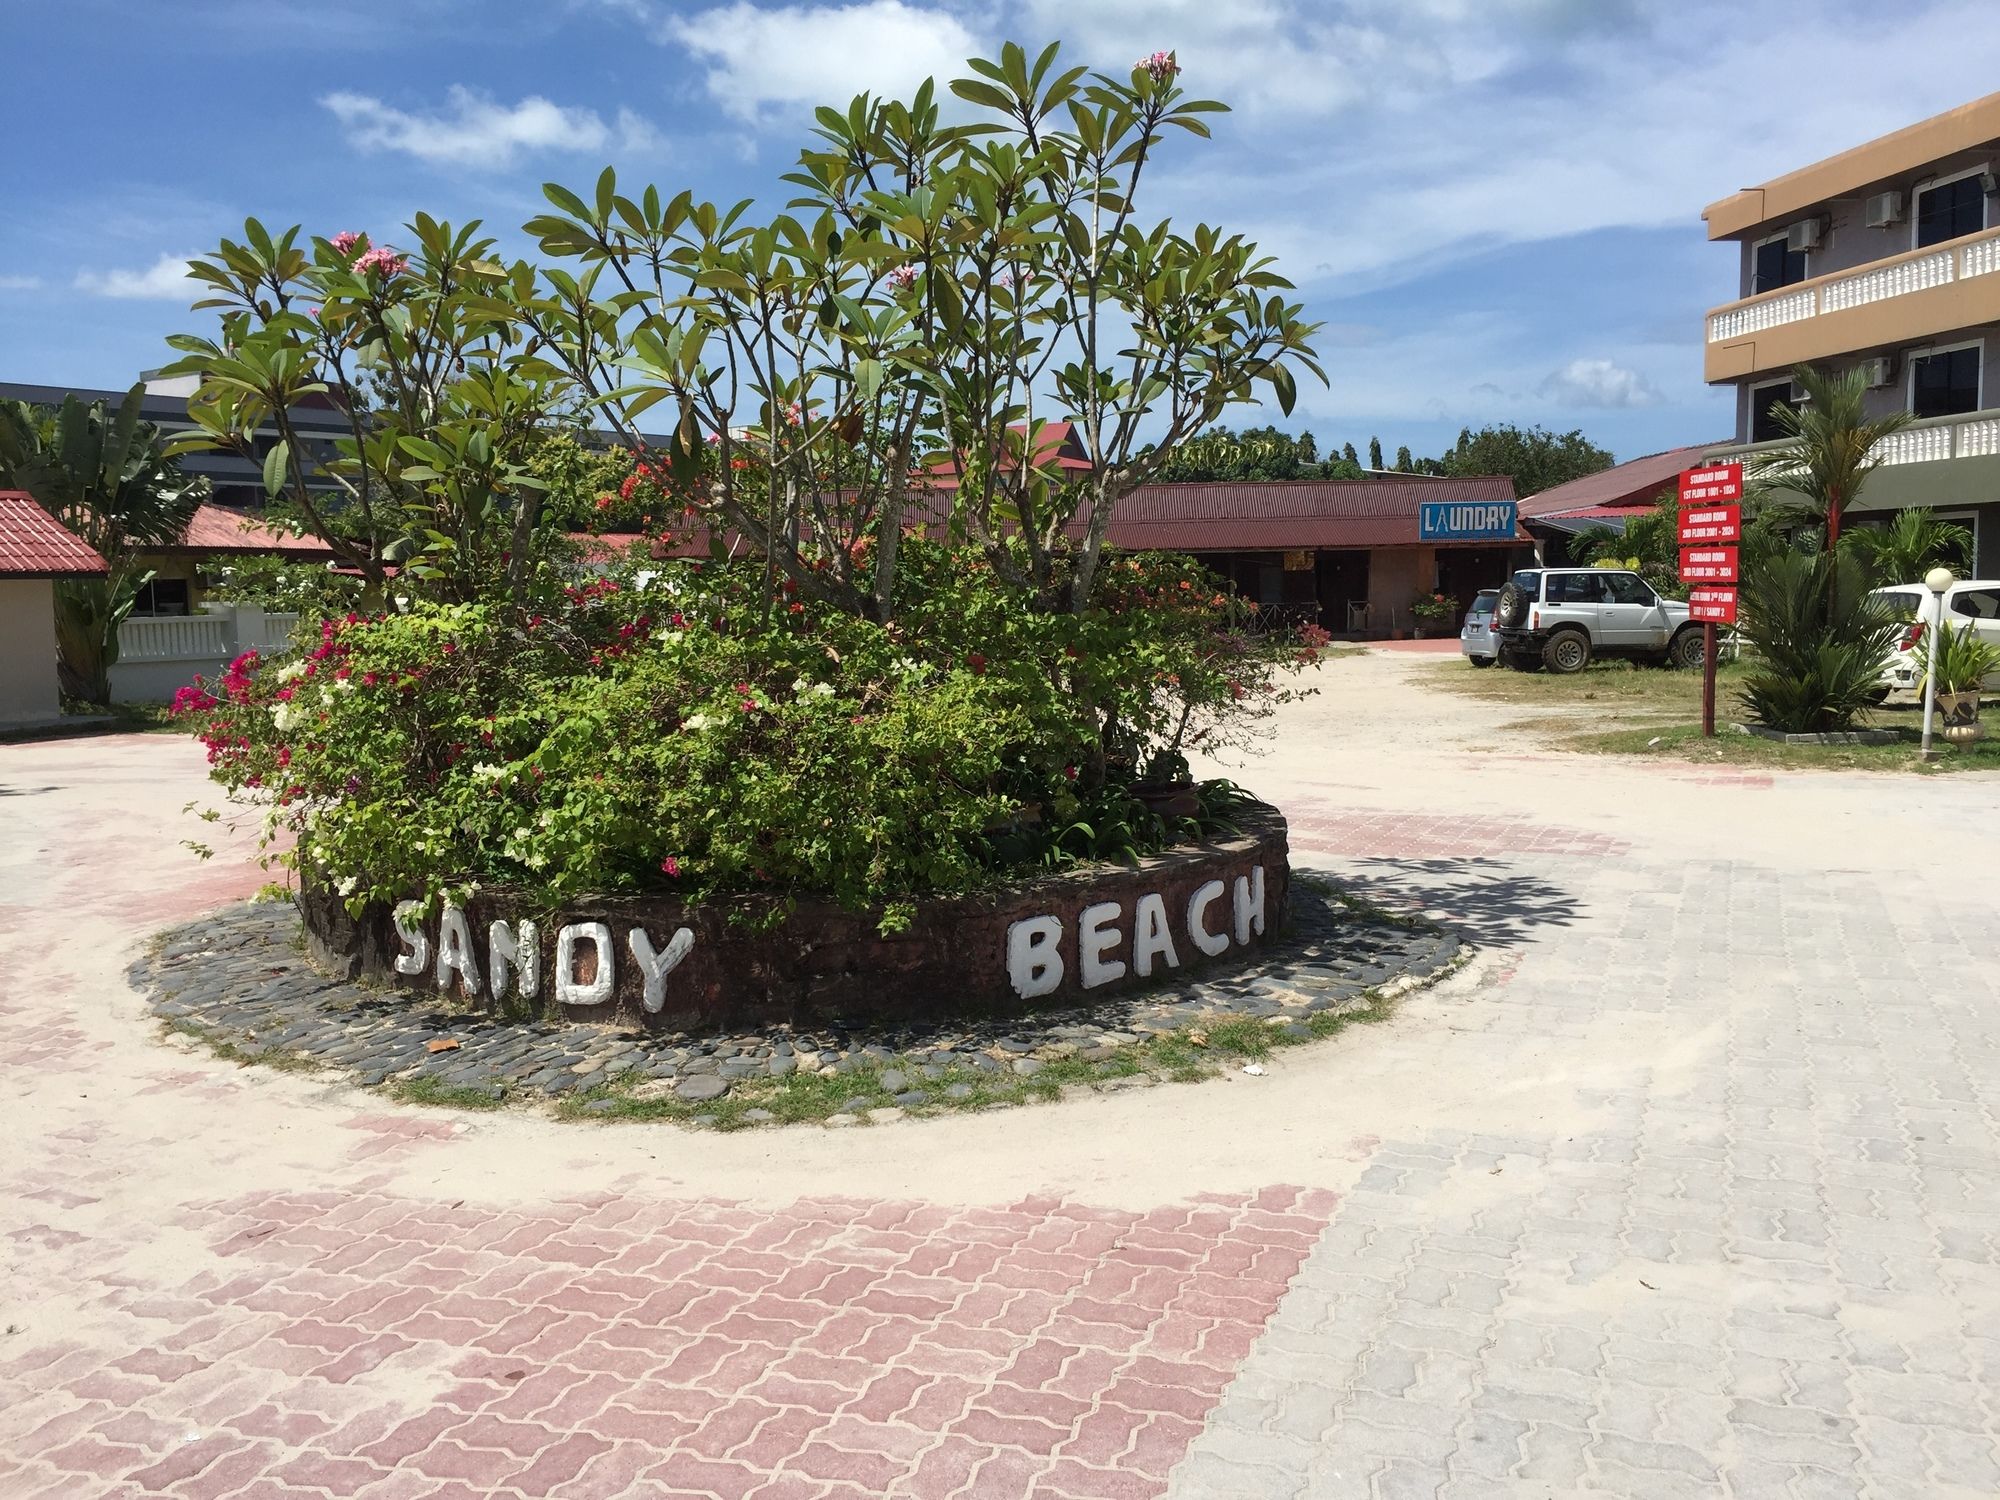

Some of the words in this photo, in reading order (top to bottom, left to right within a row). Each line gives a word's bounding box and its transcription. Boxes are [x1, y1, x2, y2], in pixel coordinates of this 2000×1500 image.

[1714, 470, 1729, 481] ROOM
[1683, 490, 1691, 499] 1ST
[1692, 488, 1706, 498] FLOOR
[1424, 505, 1511, 532] LAUNDRY
[1713, 511, 1727, 522] ROOM
[1692, 527, 1706, 538] FLOOR
[1692, 567, 1704, 577] FLOOR
[1718, 592, 1733, 603] FLOOR
[1721, 607, 1725, 617] 2
[393, 900, 695, 1013] SANDY
[1006, 865, 1265, 999] BEACH
